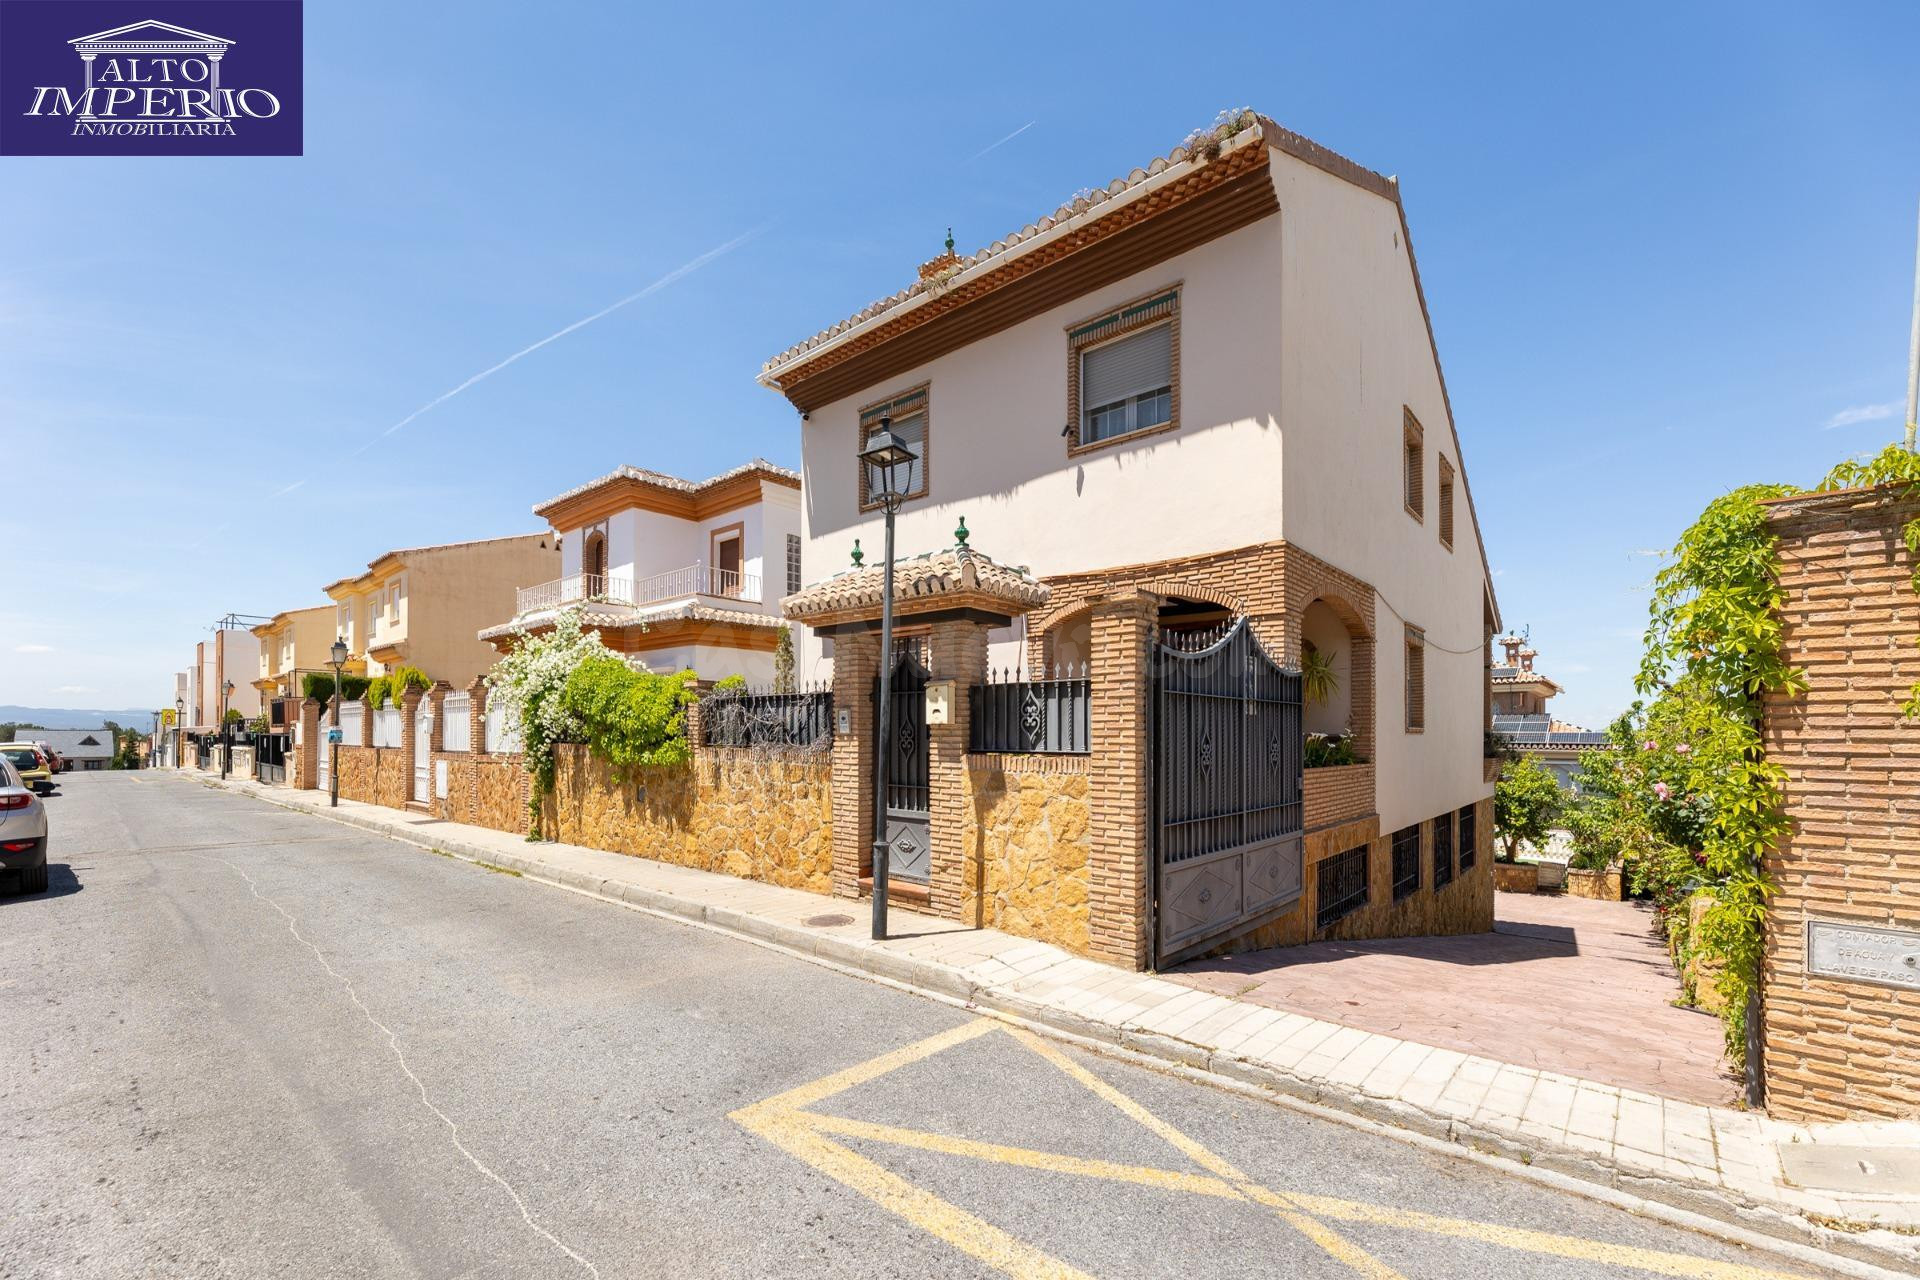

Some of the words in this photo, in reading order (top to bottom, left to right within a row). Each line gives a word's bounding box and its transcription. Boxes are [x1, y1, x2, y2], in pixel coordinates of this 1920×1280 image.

[1837, 930, 1897, 945] CONTADOR
[1838, 947, 1852, 957] DE
[1860, 967, 1877, 978] DE
[1880, 970, 1914, 983] PASO
